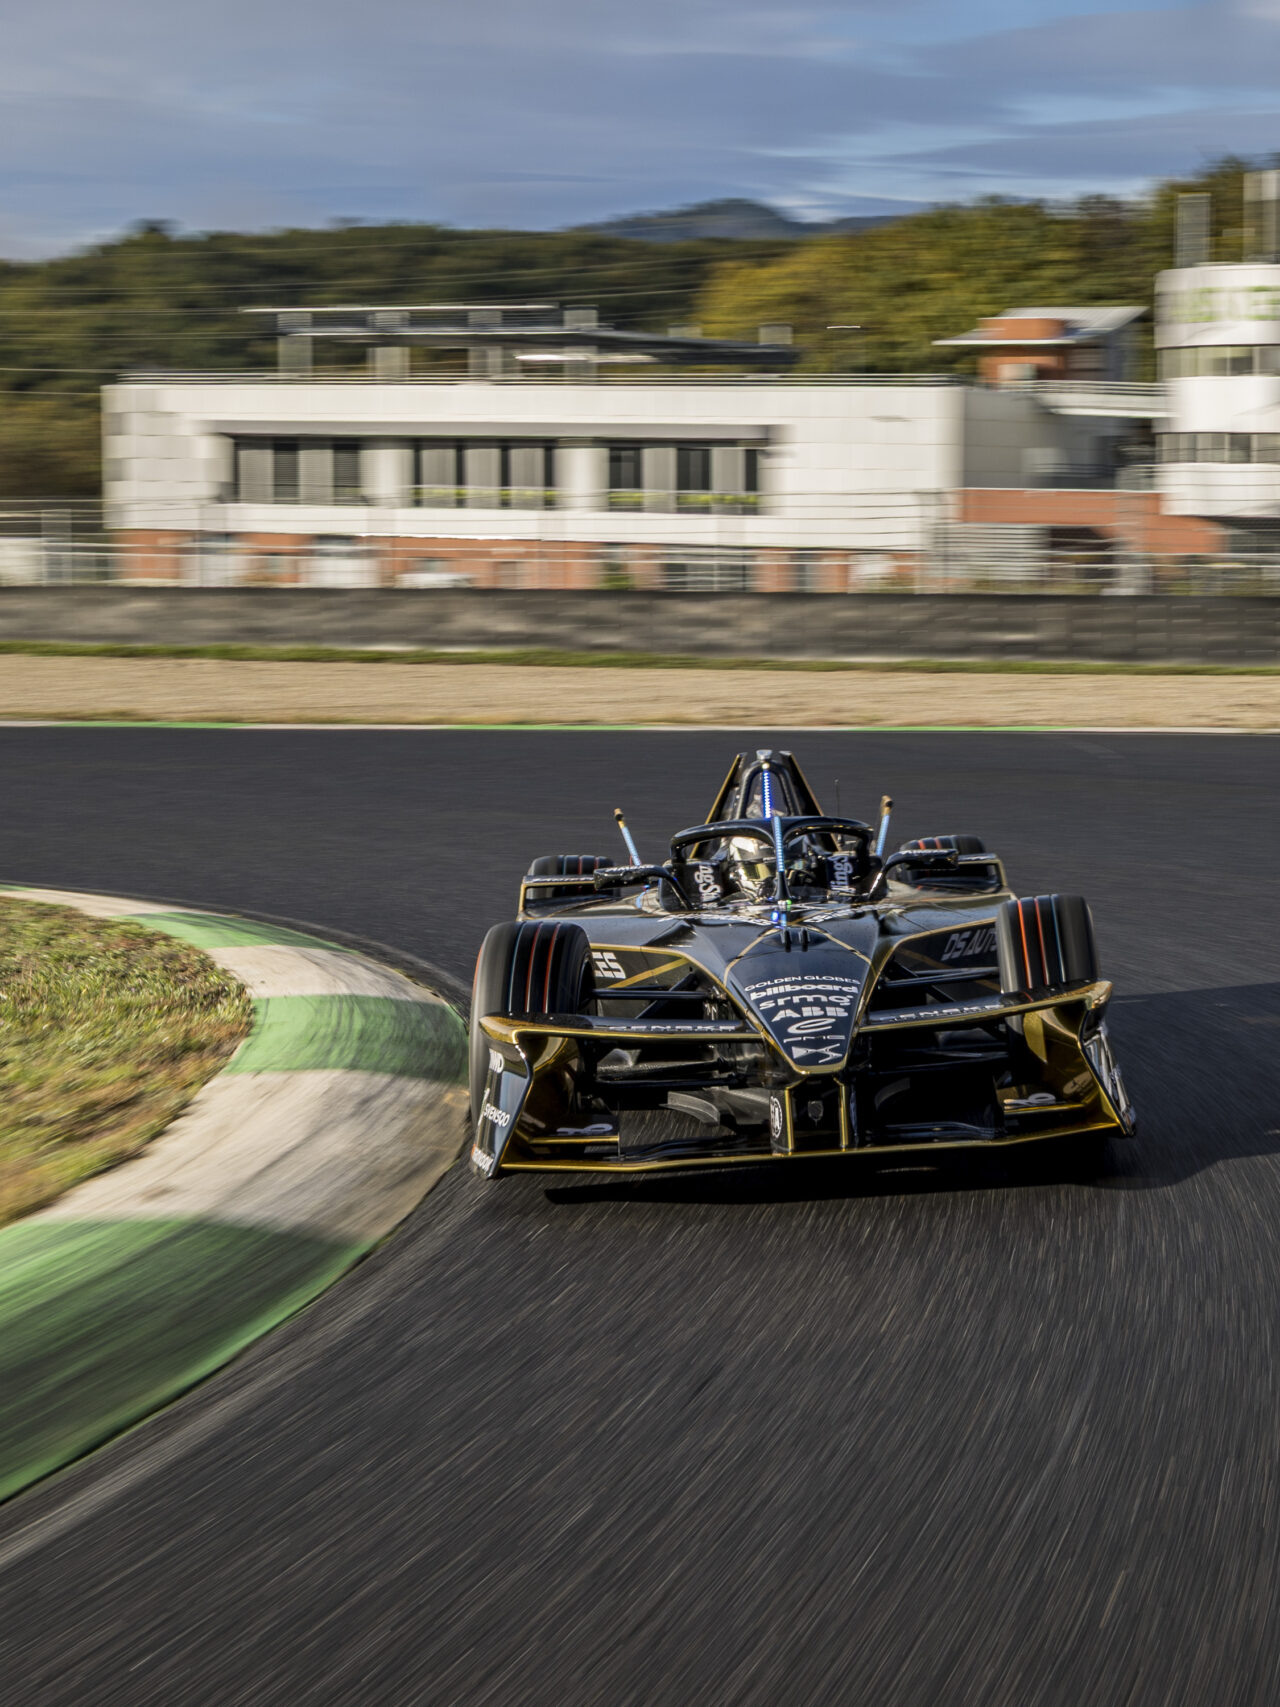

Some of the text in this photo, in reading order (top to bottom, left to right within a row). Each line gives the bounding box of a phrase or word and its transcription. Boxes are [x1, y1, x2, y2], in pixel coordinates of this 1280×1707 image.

[941, 931, 971, 961] DS
[744, 975, 861, 992] GOLDEN GLOBES
[749, 984, 859, 1001] billboard
[771, 1006, 849, 1022] ABB
